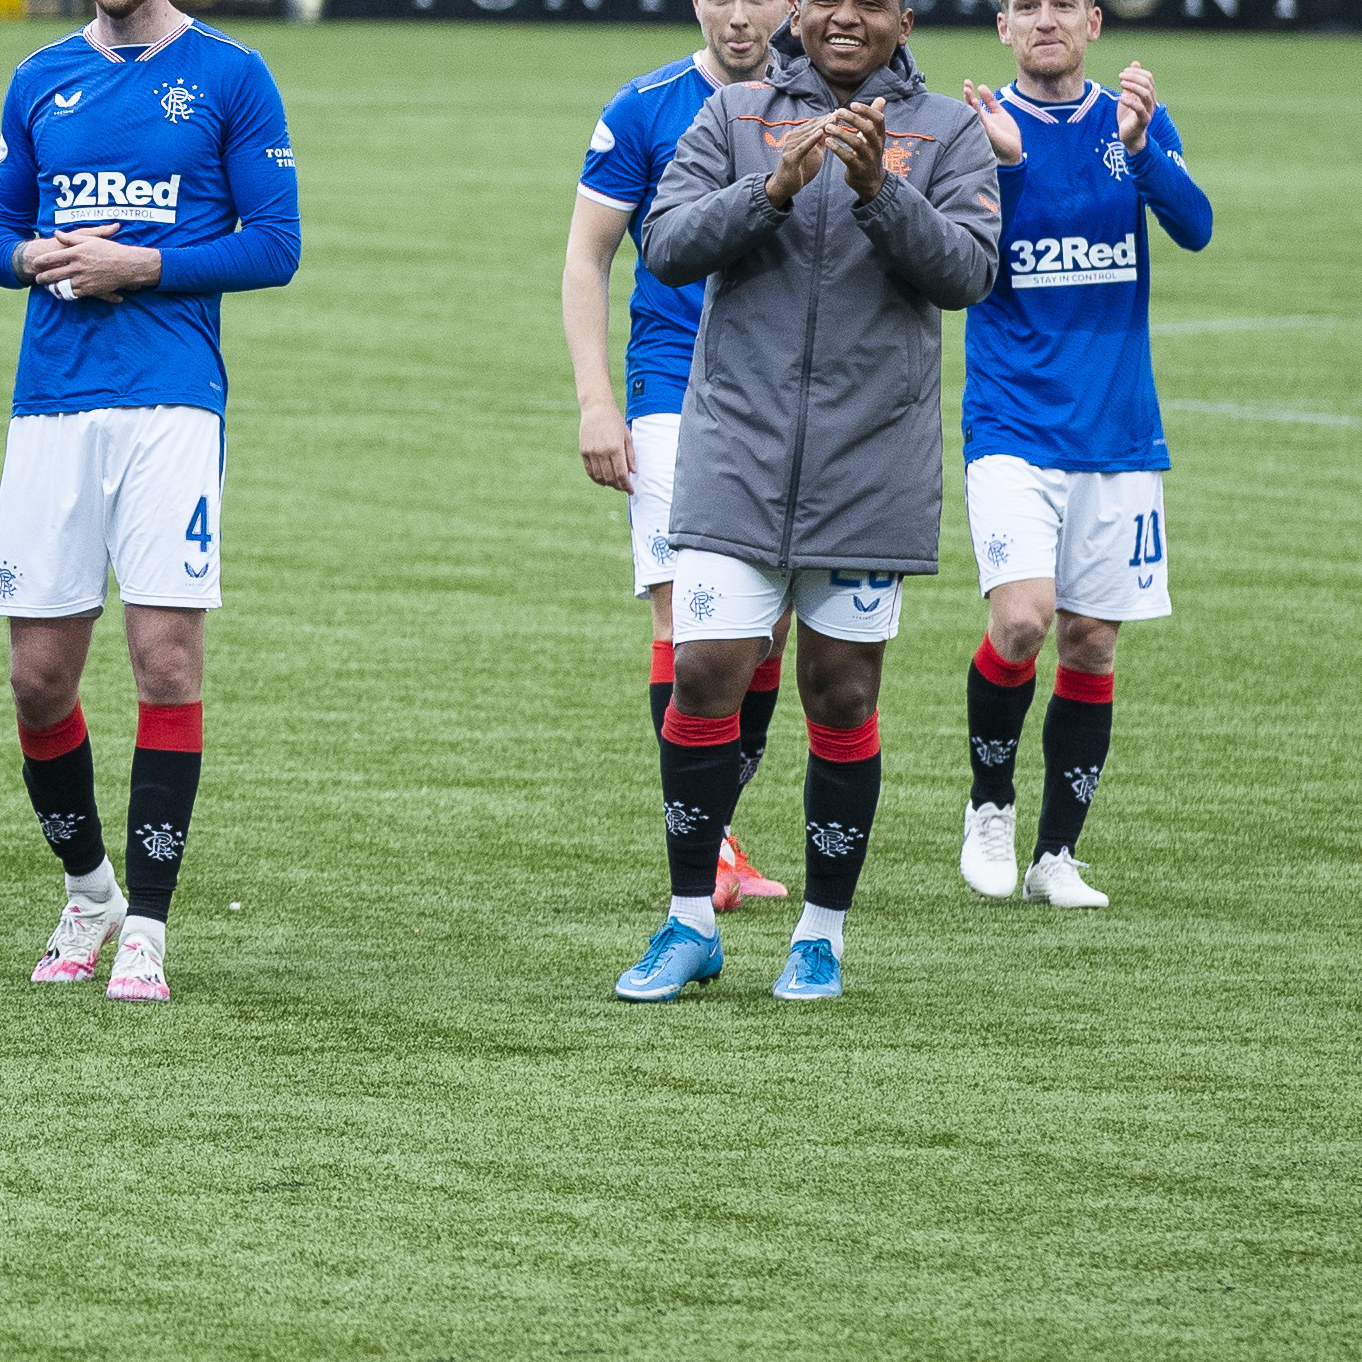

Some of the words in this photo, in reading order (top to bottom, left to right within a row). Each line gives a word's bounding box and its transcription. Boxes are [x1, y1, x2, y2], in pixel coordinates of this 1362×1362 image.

[52, 172, 181, 208] 32Red
[70, 209, 91, 220] STAY
[94, 209, 104, 219] IN
[111, 208, 155, 220] CONTROL
[1010, 233, 1137, 272] 32Red
[1033, 274, 1057, 285] STAY
[1060, 273, 1070, 283] IN
[1072, 270, 1117, 283] CONTROL
[185, 495, 212, 553] 4
[1129, 509, 1163, 568] 10
